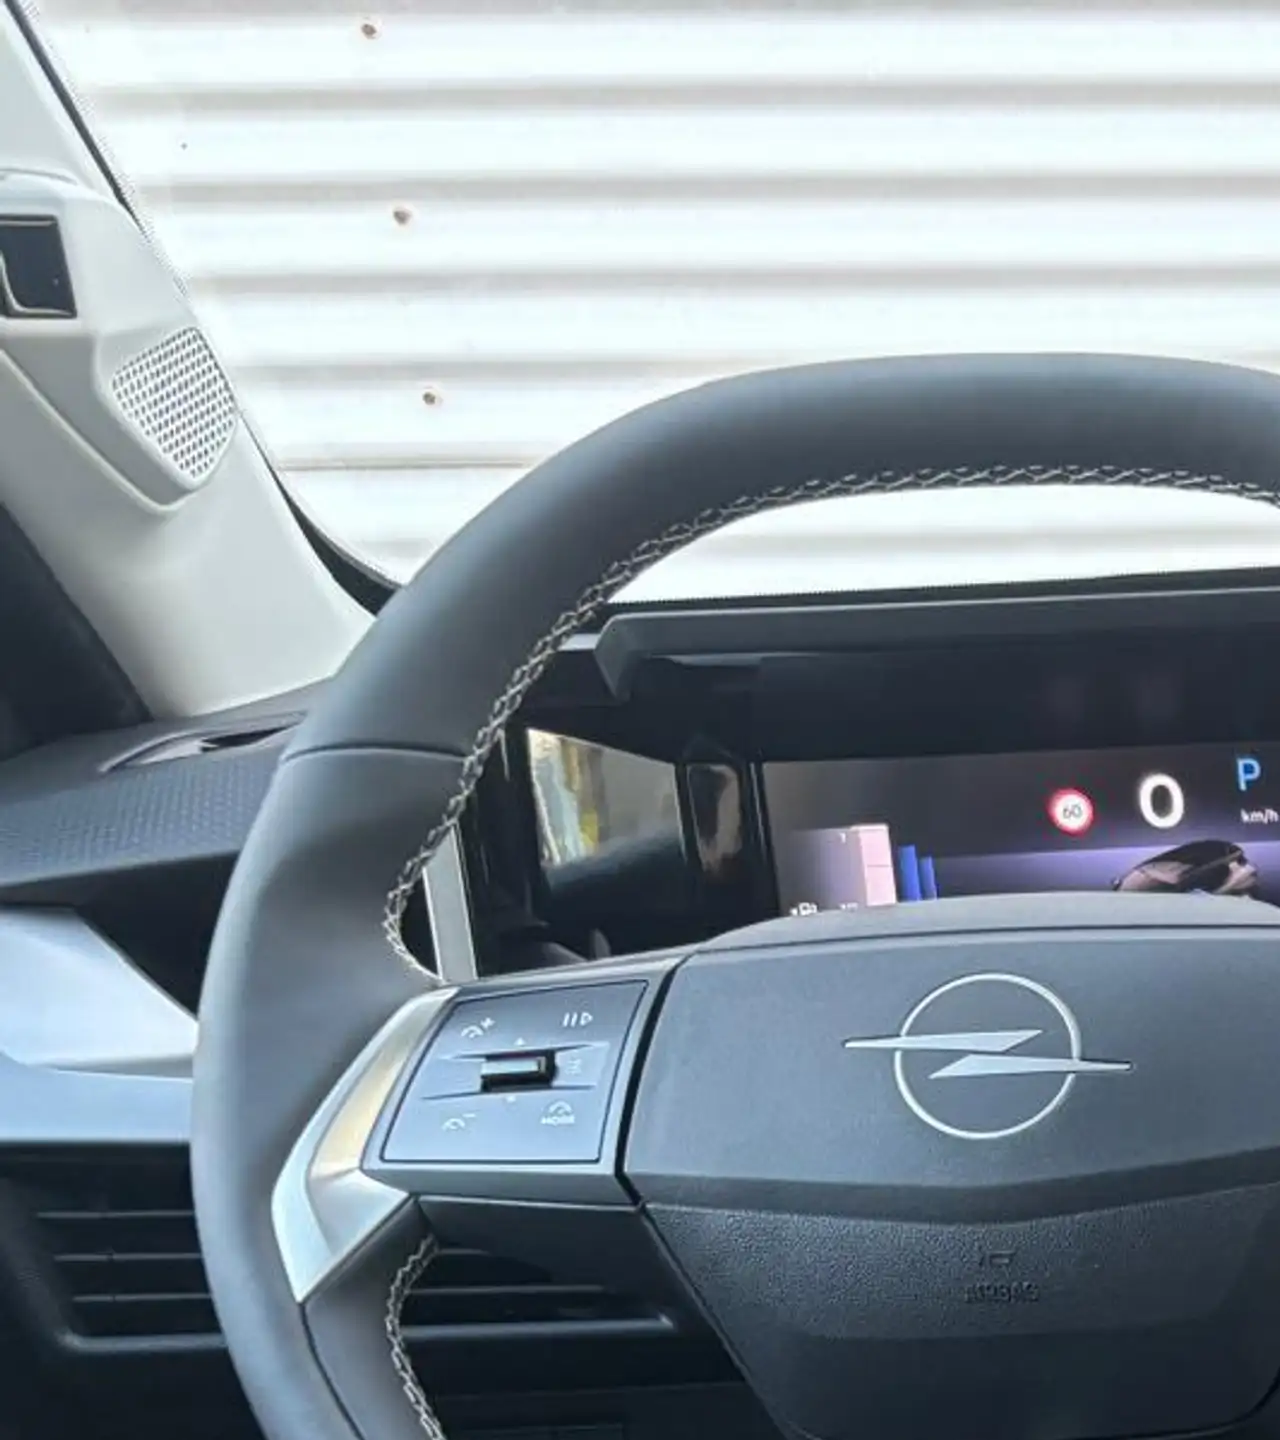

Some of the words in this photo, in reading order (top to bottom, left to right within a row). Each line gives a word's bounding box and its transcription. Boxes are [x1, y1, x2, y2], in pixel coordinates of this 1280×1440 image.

[1237, 758, 1260, 790] P
[1139, 773, 1184, 829] 0
[1241, 808, 1279, 824] km/h
